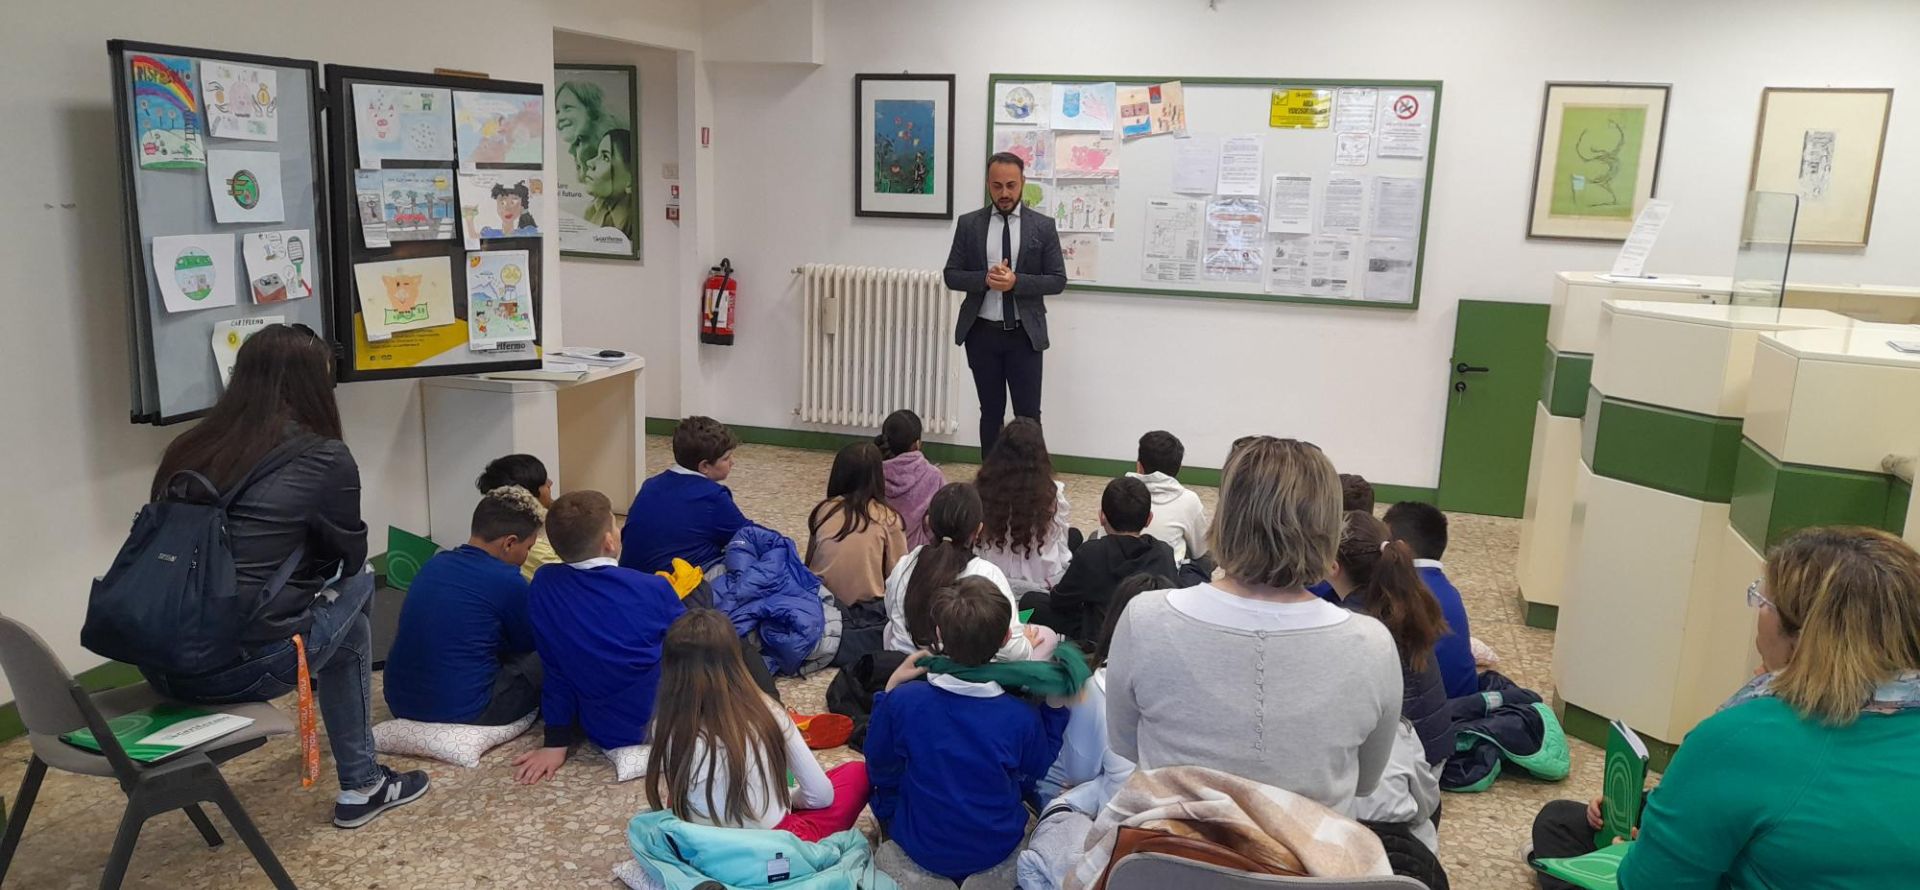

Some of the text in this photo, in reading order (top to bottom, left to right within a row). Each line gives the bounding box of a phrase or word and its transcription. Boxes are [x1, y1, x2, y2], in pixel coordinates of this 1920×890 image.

[562, 190, 582, 198] futuro
[496, 341, 526, 350] rifermo
[301, 706, 309, 730] VIOLA
[309, 729, 317, 754] VIOLA
[383, 781, 402, 803] N
